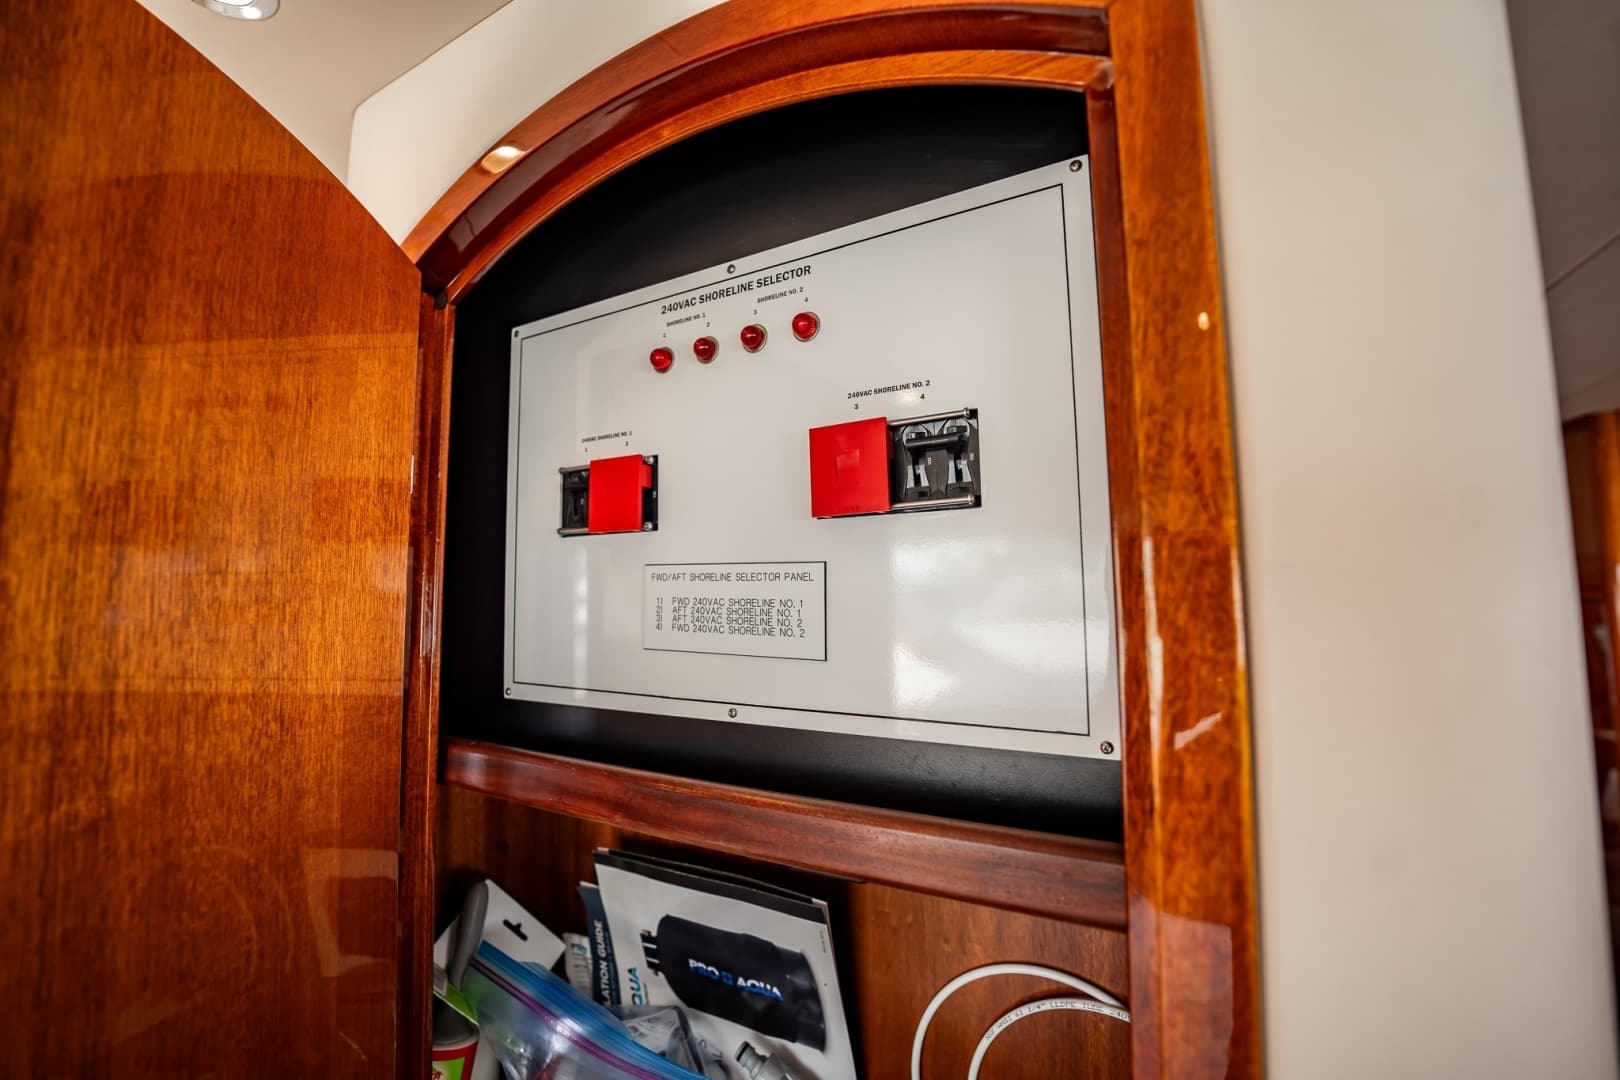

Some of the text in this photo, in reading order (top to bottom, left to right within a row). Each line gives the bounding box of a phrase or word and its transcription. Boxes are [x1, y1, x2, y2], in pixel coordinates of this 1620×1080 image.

[661, 265, 812, 315] 240VAC SHORELINE SELECTOR
[757, 290, 788, 304] SHORELINE
[848, 389, 872, 400] 240VAC
[874, 382, 911, 395] SHORELINE
[651, 572, 814, 582] FWD/AFT SHORELINE SELECTOR PANEL
[656, 597, 804, 608] 1) FWD 240VAC SHORELINE NO. 1
[672, 606, 687, 614] AFT
[690, 607, 722, 616] 240VAC
[726, 607, 773, 617] SHORELINE
[777, 608, 793, 618] NO.
[797, 608, 801, 617] 1
[672, 614, 687, 623] AFT
[690, 615, 722, 624] 240VAC
[726, 616, 773, 626] SHORELINE
[777, 618, 793, 628] NO.
[797, 618, 802, 628] 2
[672, 624, 690, 632] FWD
[693, 624, 725, 634] 240VAC
[728, 626, 776, 637] SHORELINE
[780, 628, 796, 638] NO.
[800, 628, 806, 638] 2
[594, 920, 608, 958] GUIDE
[599, 961, 611, 1006] LATION
[628, 966, 644, 1006] QUA
[688, 958, 784, 1003] PRO AQUA
